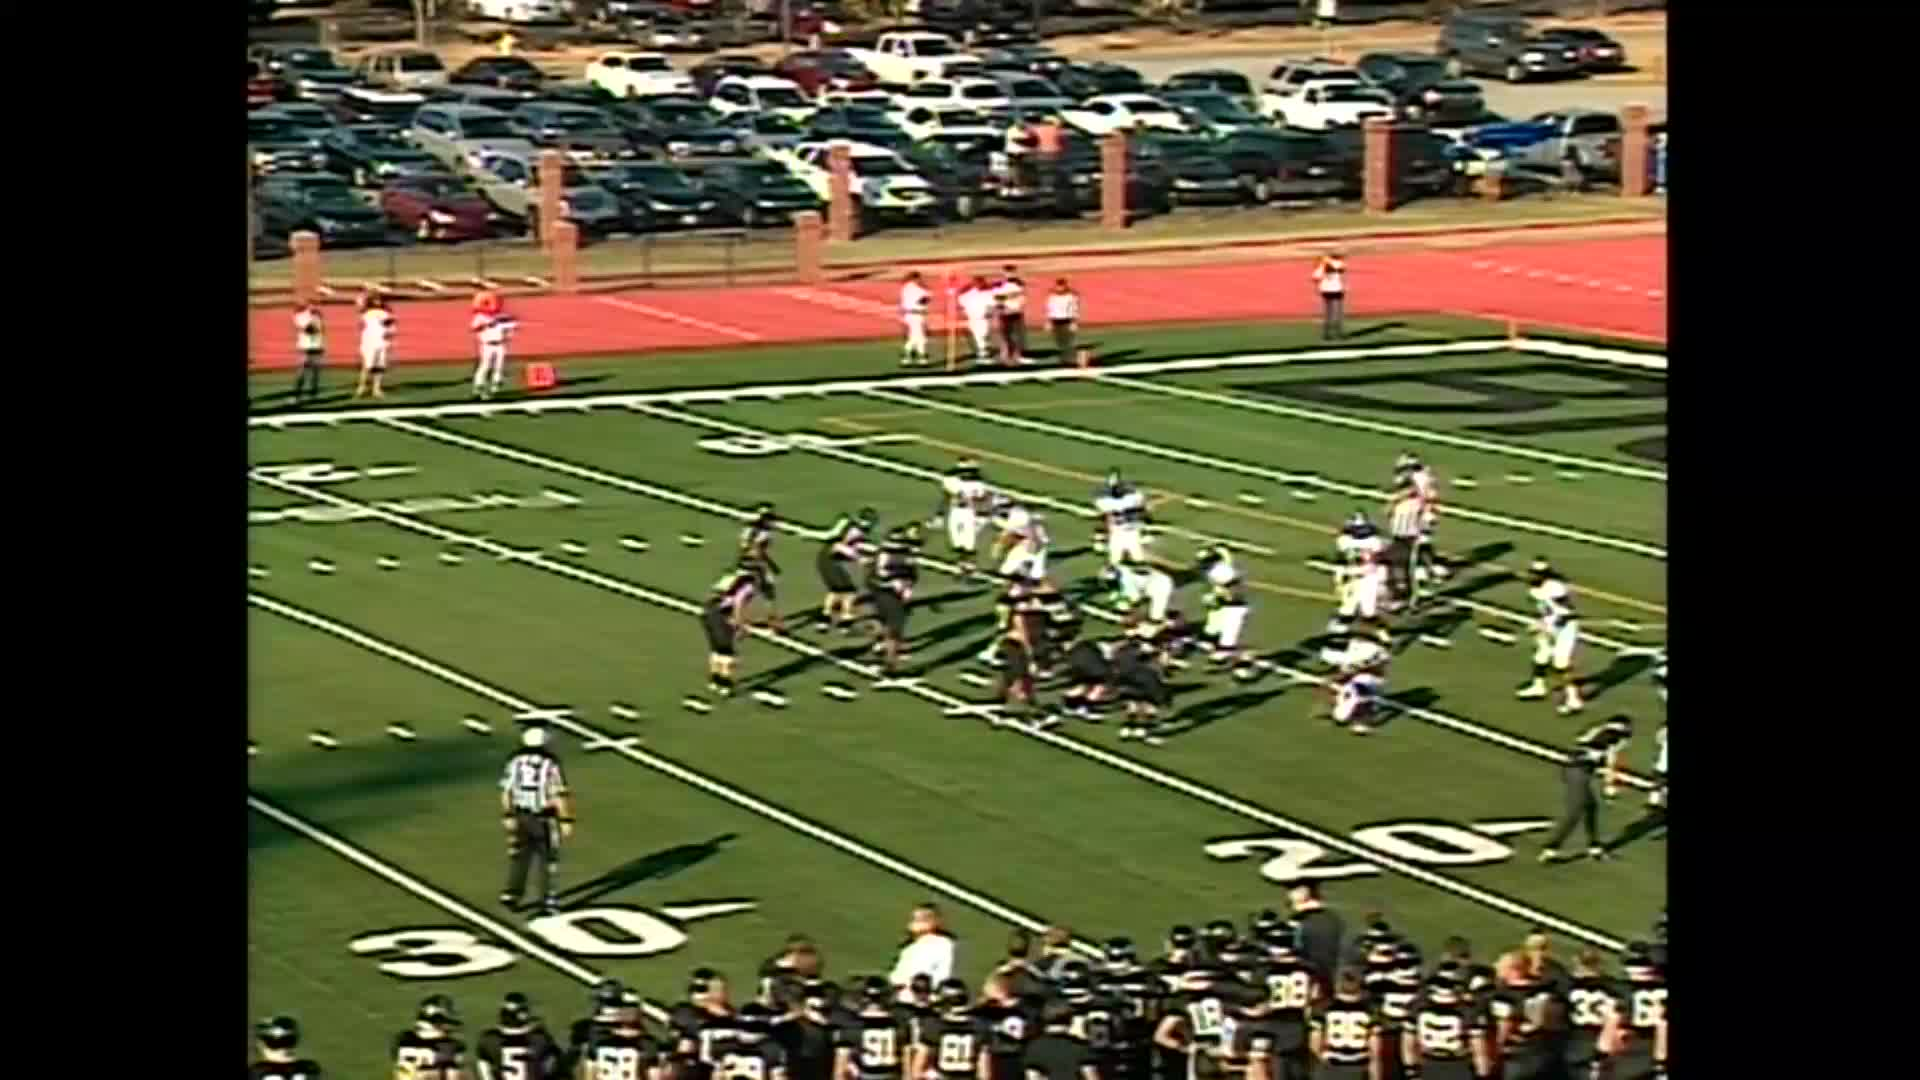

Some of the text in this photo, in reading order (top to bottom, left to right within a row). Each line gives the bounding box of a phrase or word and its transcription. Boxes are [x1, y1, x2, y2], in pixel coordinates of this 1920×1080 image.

[1204, 823, 1516, 880] 20
[349, 907, 689, 978] 30
[861, 1029, 896, 1066] 91
